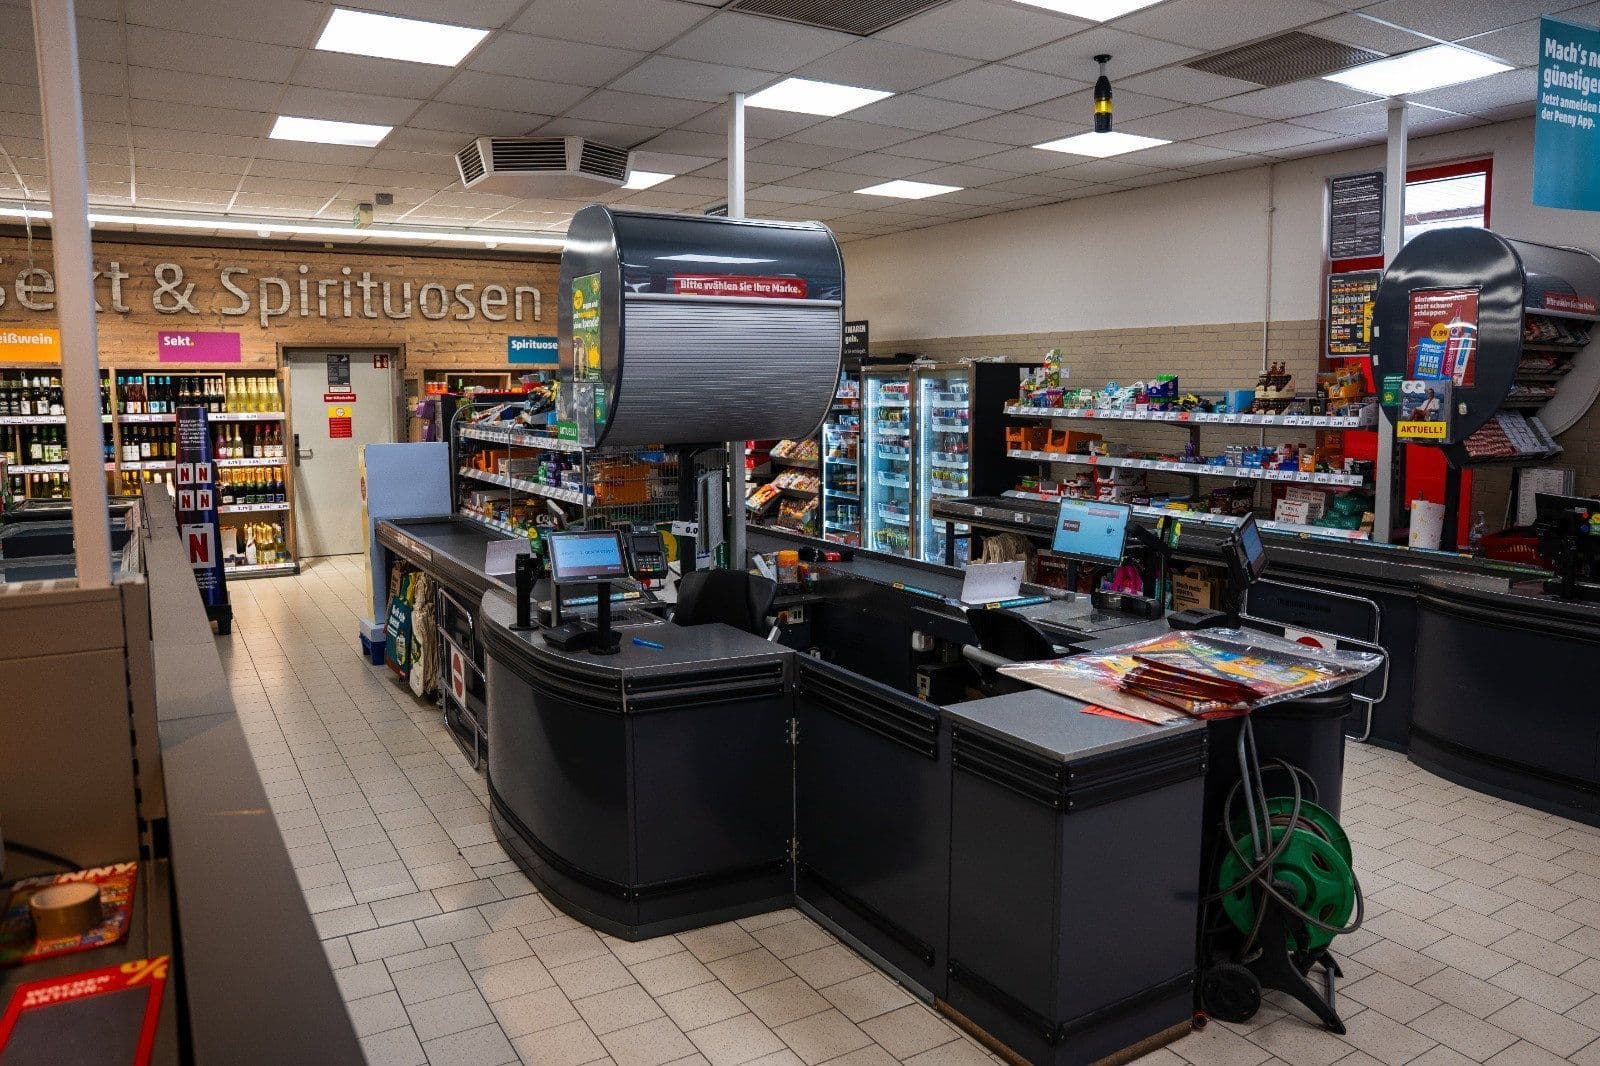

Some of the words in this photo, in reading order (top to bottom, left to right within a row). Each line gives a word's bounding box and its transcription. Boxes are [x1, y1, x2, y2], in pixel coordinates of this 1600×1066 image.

[1545, 37, 1588, 66] Mach's
[1541, 92, 1559, 107] Jetzt
[1560, 97, 1597, 114] anmelden
[1541, 107, 1554, 120] der
[1554, 110, 1577, 128] Penny
[1577, 114, 1596, 130] App.
[0, 256, 130, 314] et
[153, 263, 200, 315] &
[220, 264, 541, 328] Spirituosen
[680, 279, 703, 290] Bitte
[703, 280, 738, 291] wählen
[739, 281, 752, 291] Sie
[753, 282, 771, 292] Ihre
[771, 283, 802, 294] Marke.
[163, 335, 195, 347] Sekt.
[511, 339, 558, 351] Spirituose
[1419, 354, 1440, 363] HIER
[1400, 425, 1443, 434] AKTUELL!
[188, 532, 209, 564] N
